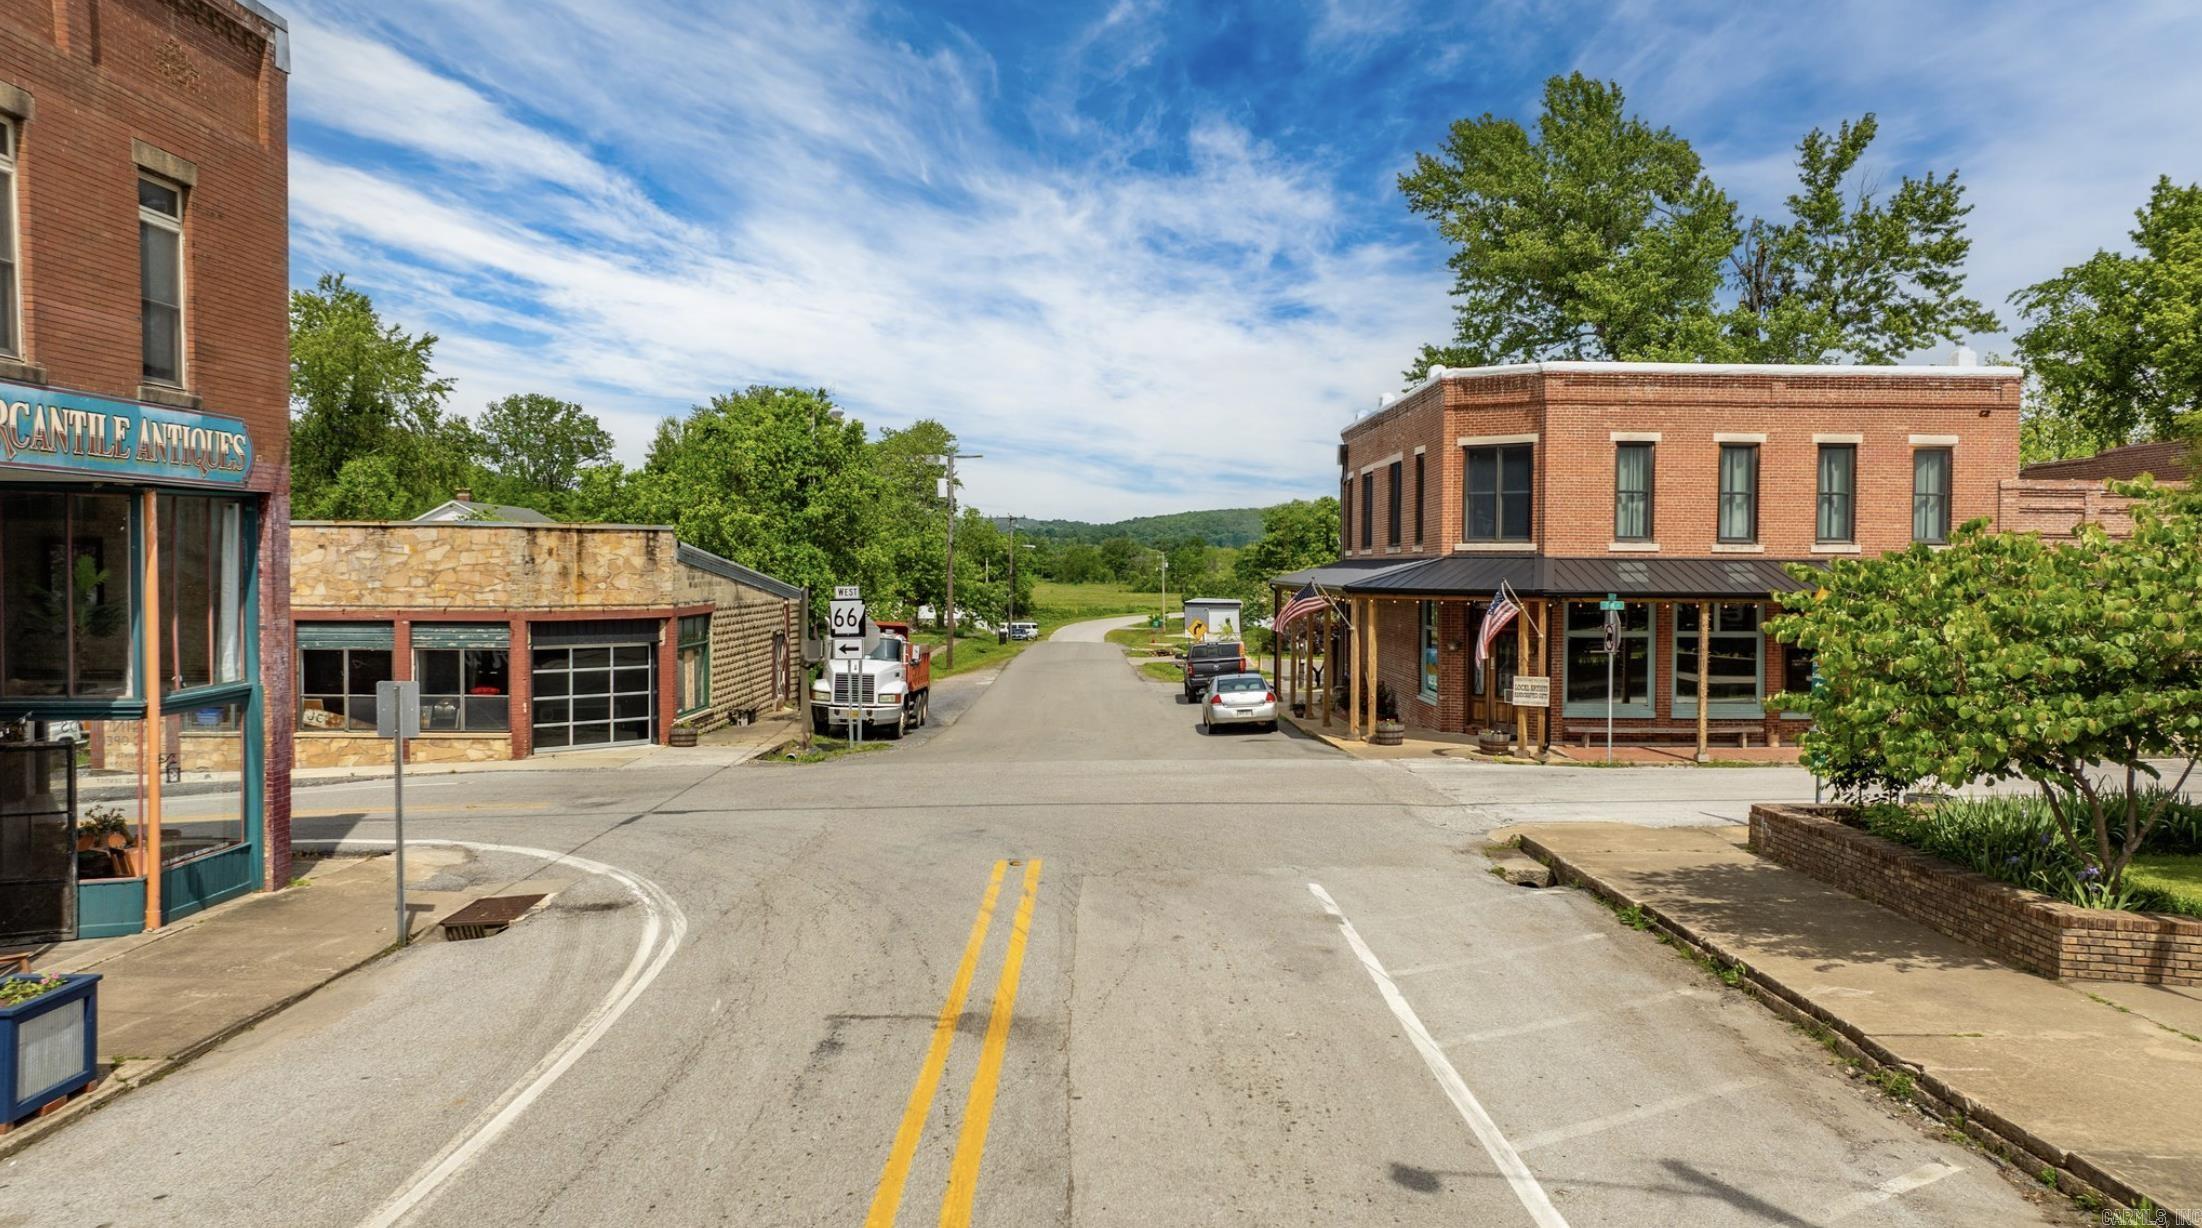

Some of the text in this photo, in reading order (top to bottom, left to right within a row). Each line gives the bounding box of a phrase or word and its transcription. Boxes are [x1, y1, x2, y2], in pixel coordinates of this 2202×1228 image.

[136, 416, 247, 478] ANTIQUES
[837, 588, 858, 597] WEST
[834, 608, 858, 628] 66
